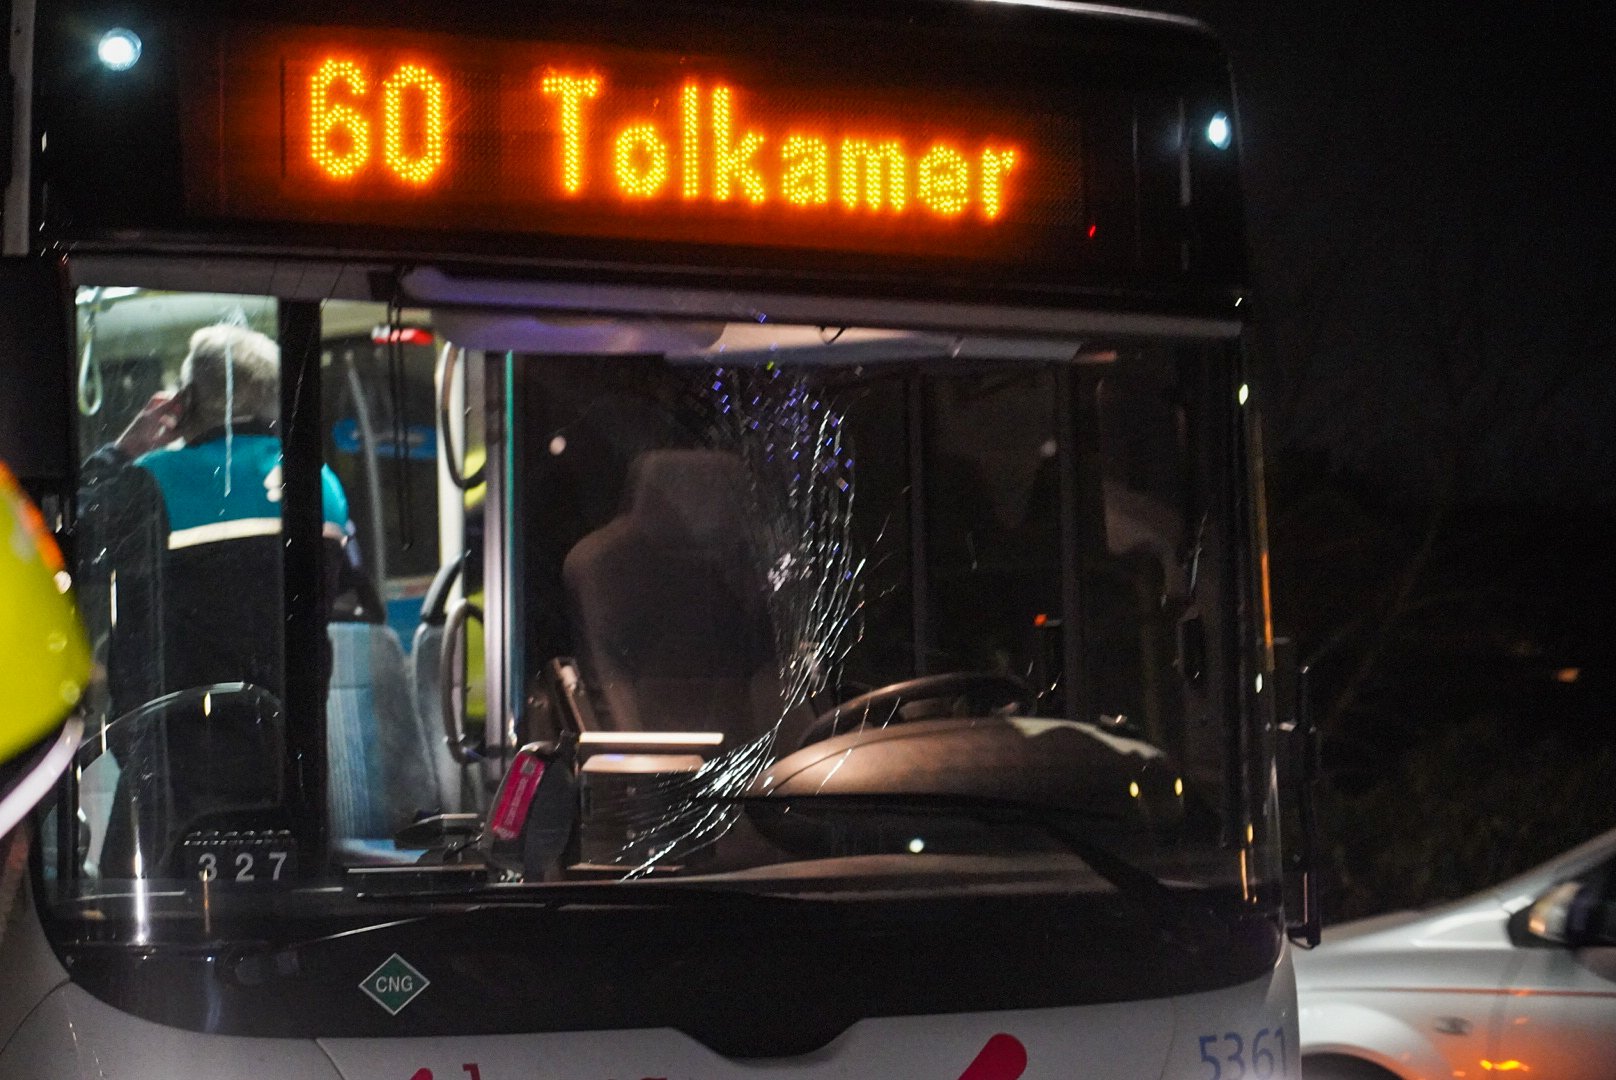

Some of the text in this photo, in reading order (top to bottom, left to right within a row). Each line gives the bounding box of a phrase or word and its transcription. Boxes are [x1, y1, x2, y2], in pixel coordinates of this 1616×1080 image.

[308, 58, 1018, 219] 60 Tolkamer
[199, 851, 287, 882] 327
[374, 974, 414, 994] CNG
[1199, 1027, 1287, 1080] 5361
